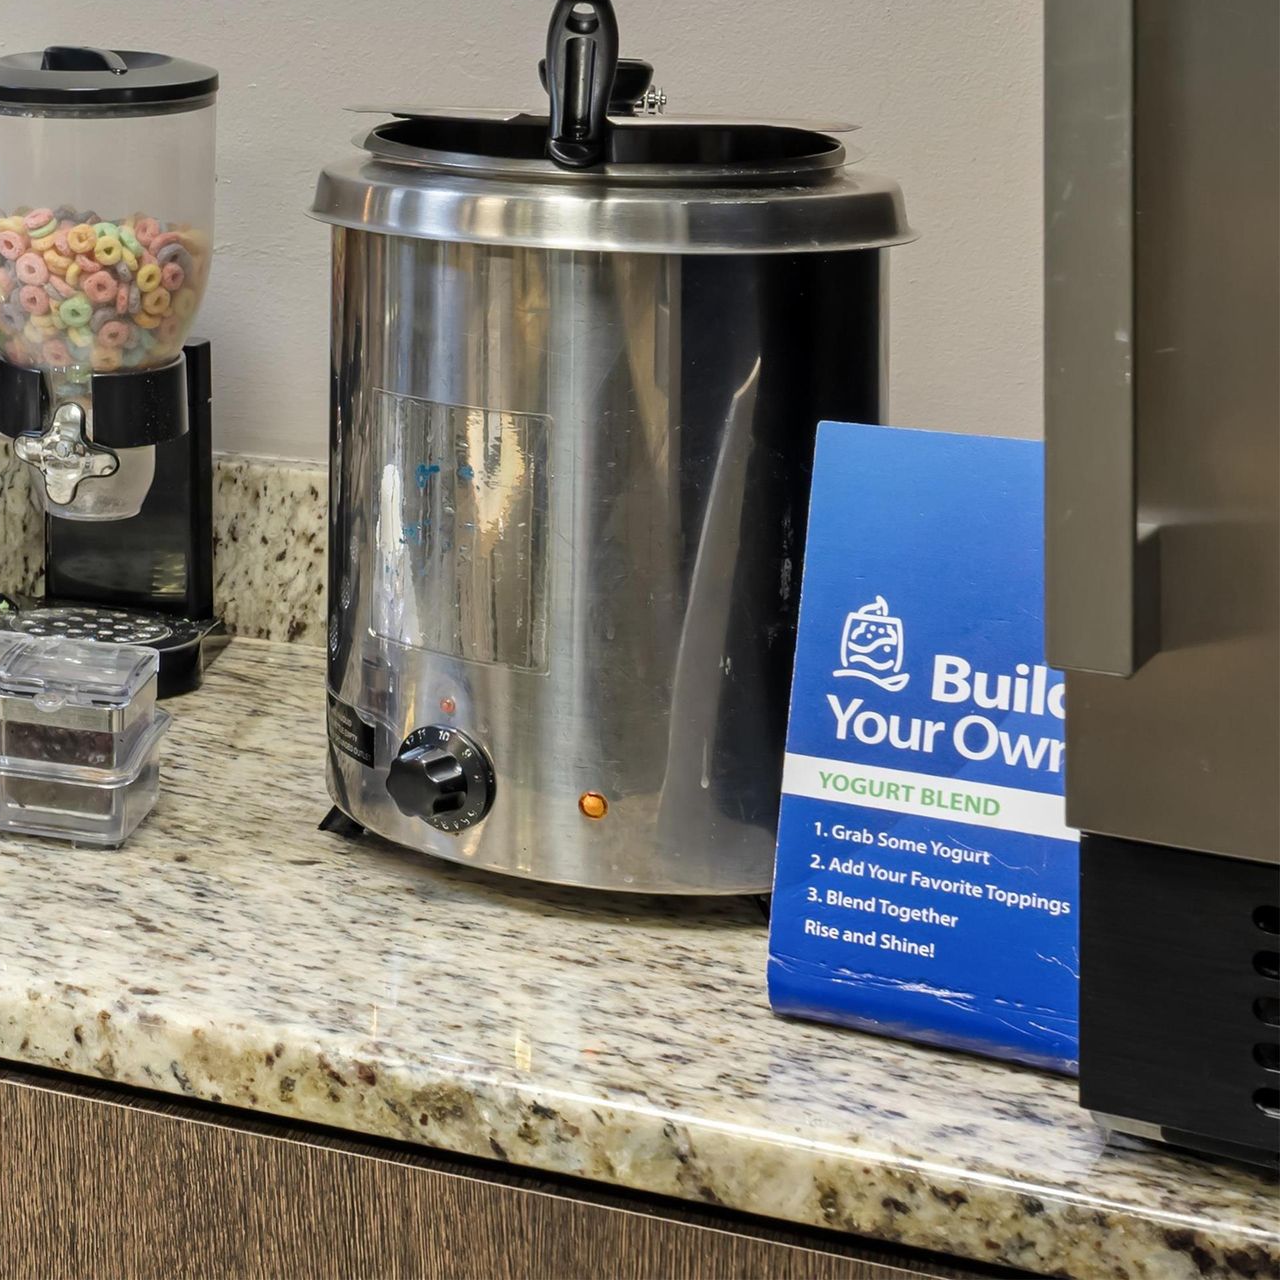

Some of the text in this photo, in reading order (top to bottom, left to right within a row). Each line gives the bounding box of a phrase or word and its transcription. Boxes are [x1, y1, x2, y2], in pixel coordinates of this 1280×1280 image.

[826, 694, 945, 753] Your
[819, 771, 1000, 816] YOGURT BLEND
[814, 821, 990, 865] 1. Grab Some Yogurt
[810, 854, 1071, 916] 2. Add Your Favorite Toppings
[807, 887, 958, 928] 3. Blend Together
[804, 919, 935, 958] Rise and Shine!
